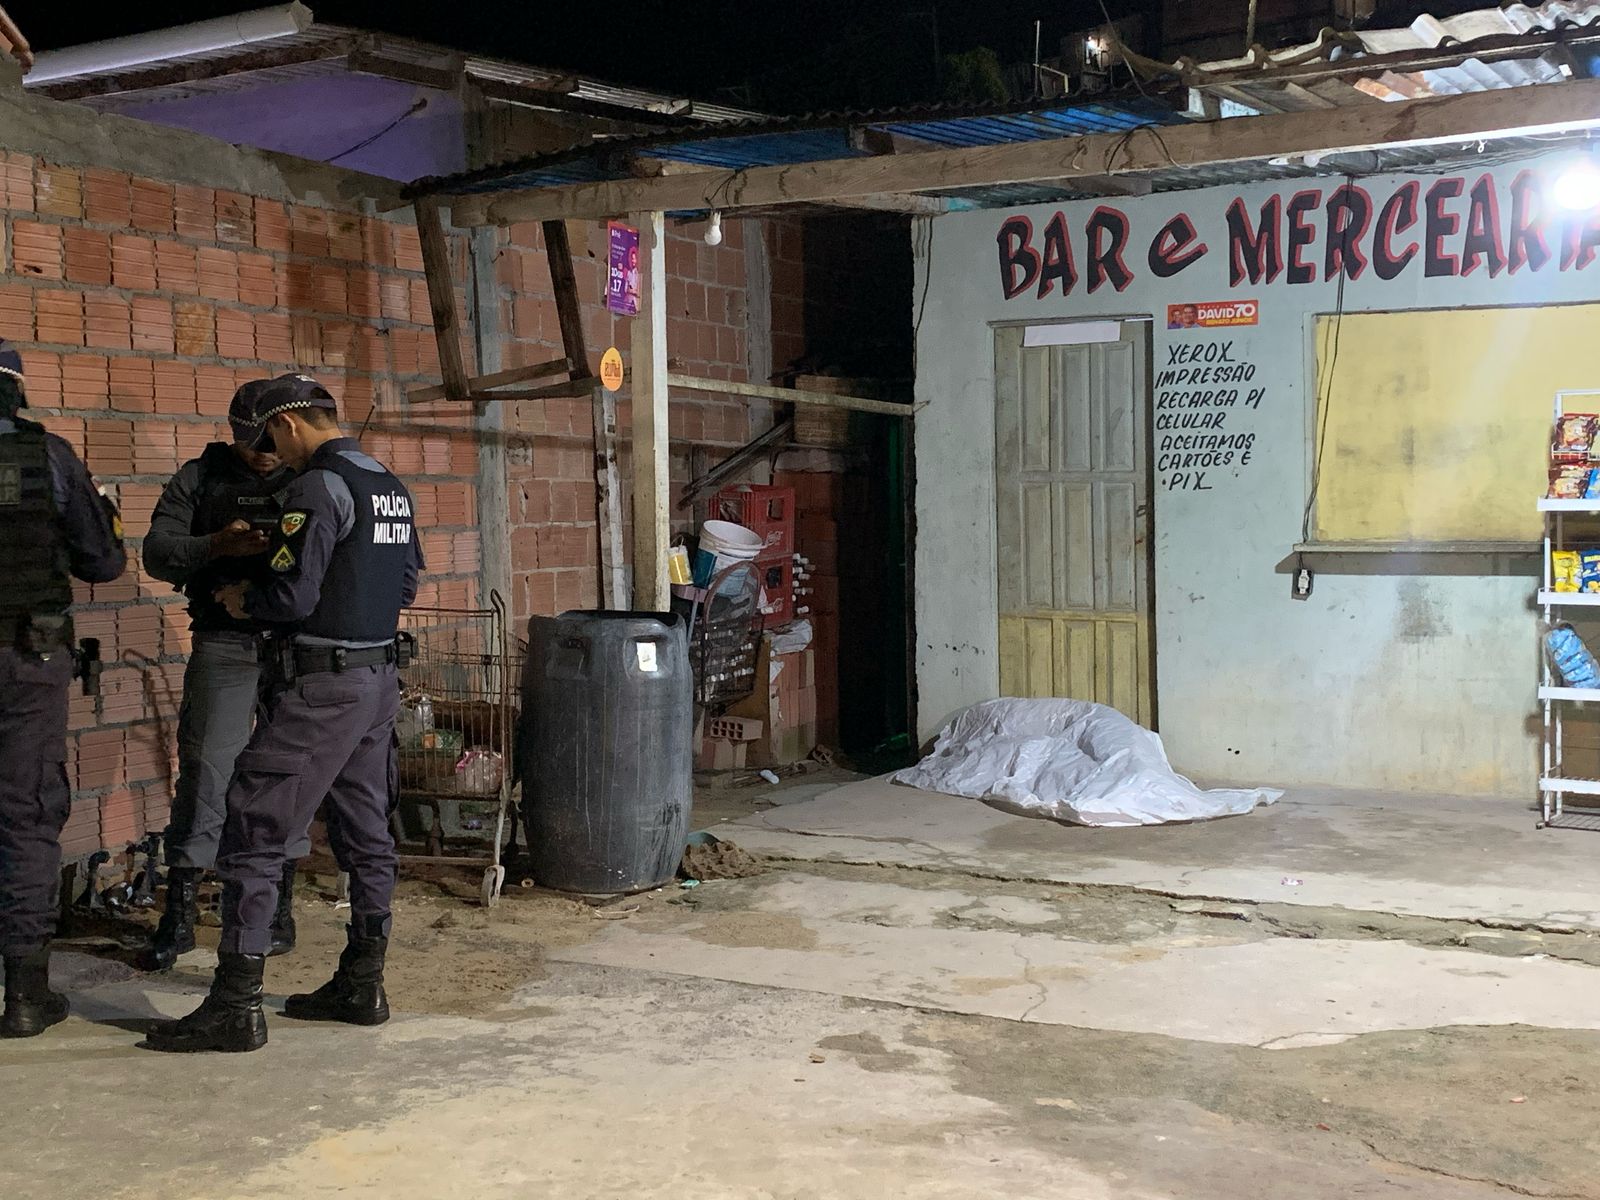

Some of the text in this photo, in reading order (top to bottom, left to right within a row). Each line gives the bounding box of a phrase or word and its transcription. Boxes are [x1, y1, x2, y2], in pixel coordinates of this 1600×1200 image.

[997, 205, 1135, 300] BAR
[1148, 212, 1209, 278] e
[1198, 303, 1256, 320] DAVID 70
[1168, 341, 1235, 366] XEROX
[1155, 362, 1256, 389] IMPRESSÃO
[1156, 389, 1238, 410] RECARGA
[1156, 412, 1226, 430] CELULAR
[1161, 432, 1255, 451] ACEITAMOS
[1158, 450, 1252, 471] CARTÕES E
[1168, 471, 1213, 491] PIX
[371, 490, 411, 518] POLÍCIA
[373, 522, 411, 544] MILITAR
